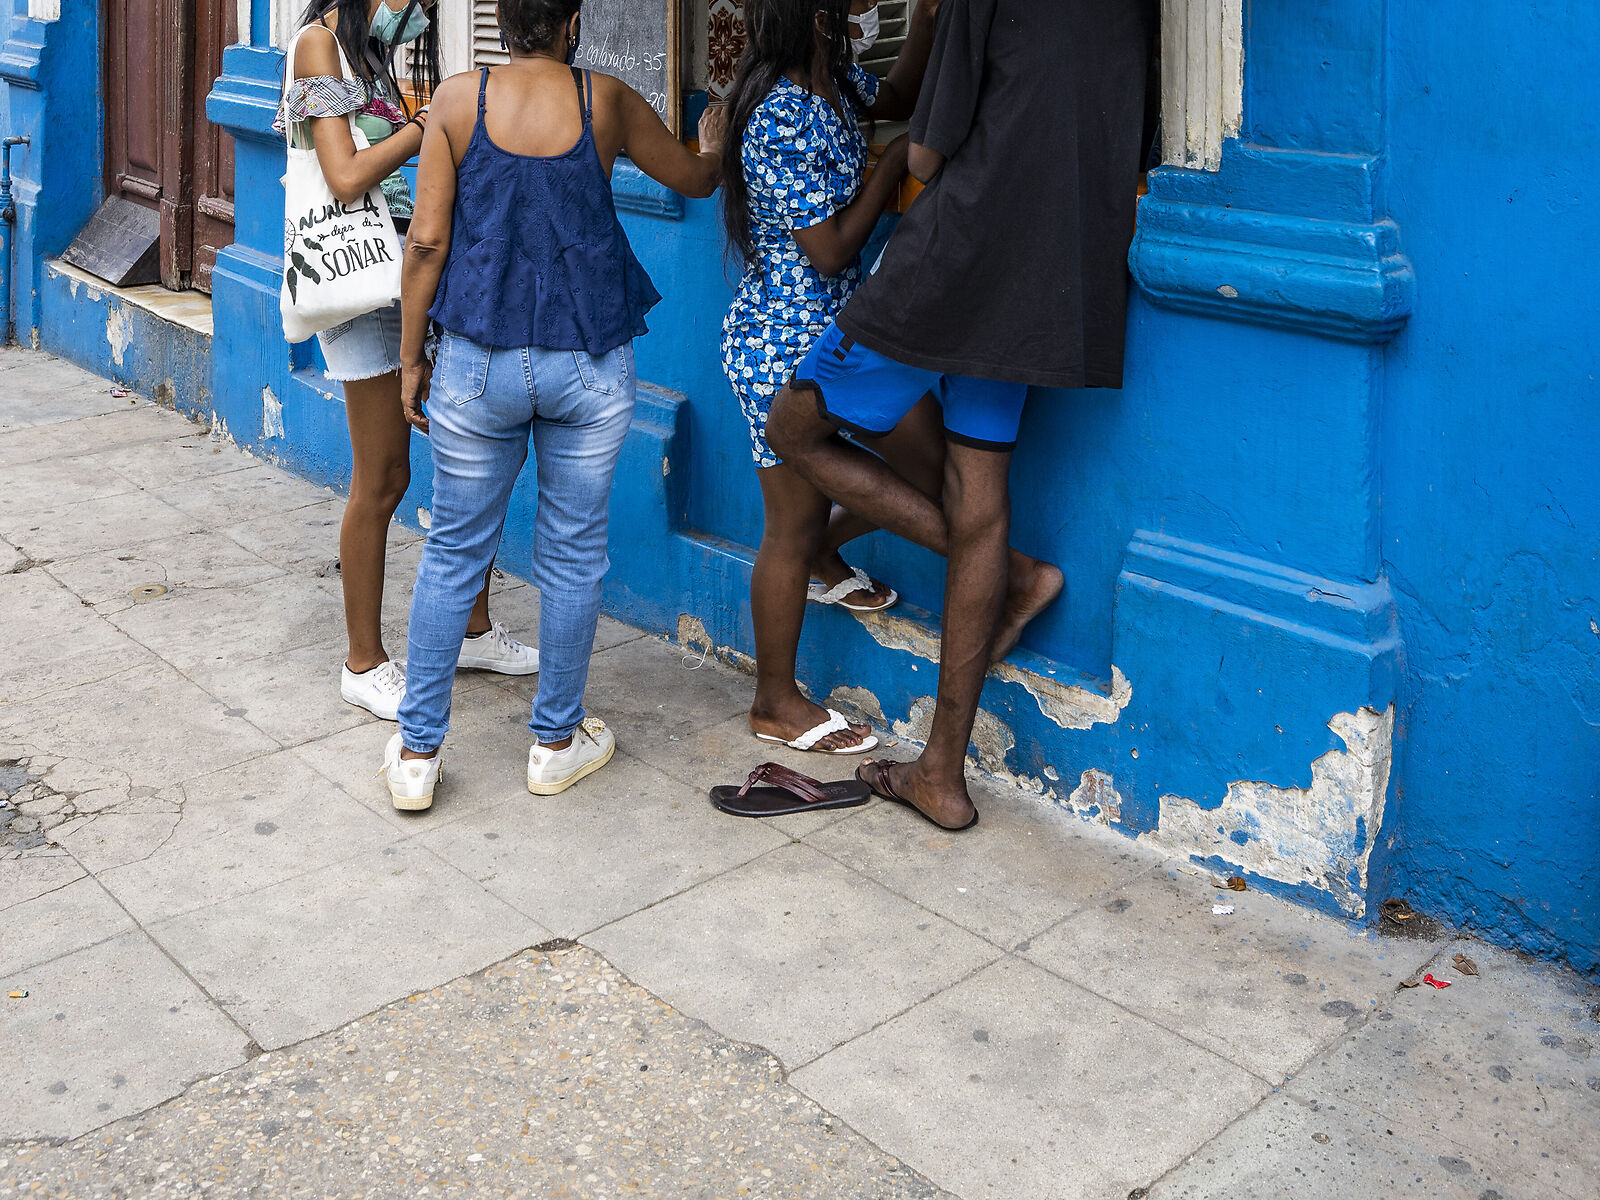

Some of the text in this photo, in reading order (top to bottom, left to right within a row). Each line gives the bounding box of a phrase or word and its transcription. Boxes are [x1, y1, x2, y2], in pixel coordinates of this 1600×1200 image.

[299, 191, 380, 231] NUNCA
[330, 216, 373, 242] dejes de
[321, 238, 395, 282] SOÑAR
